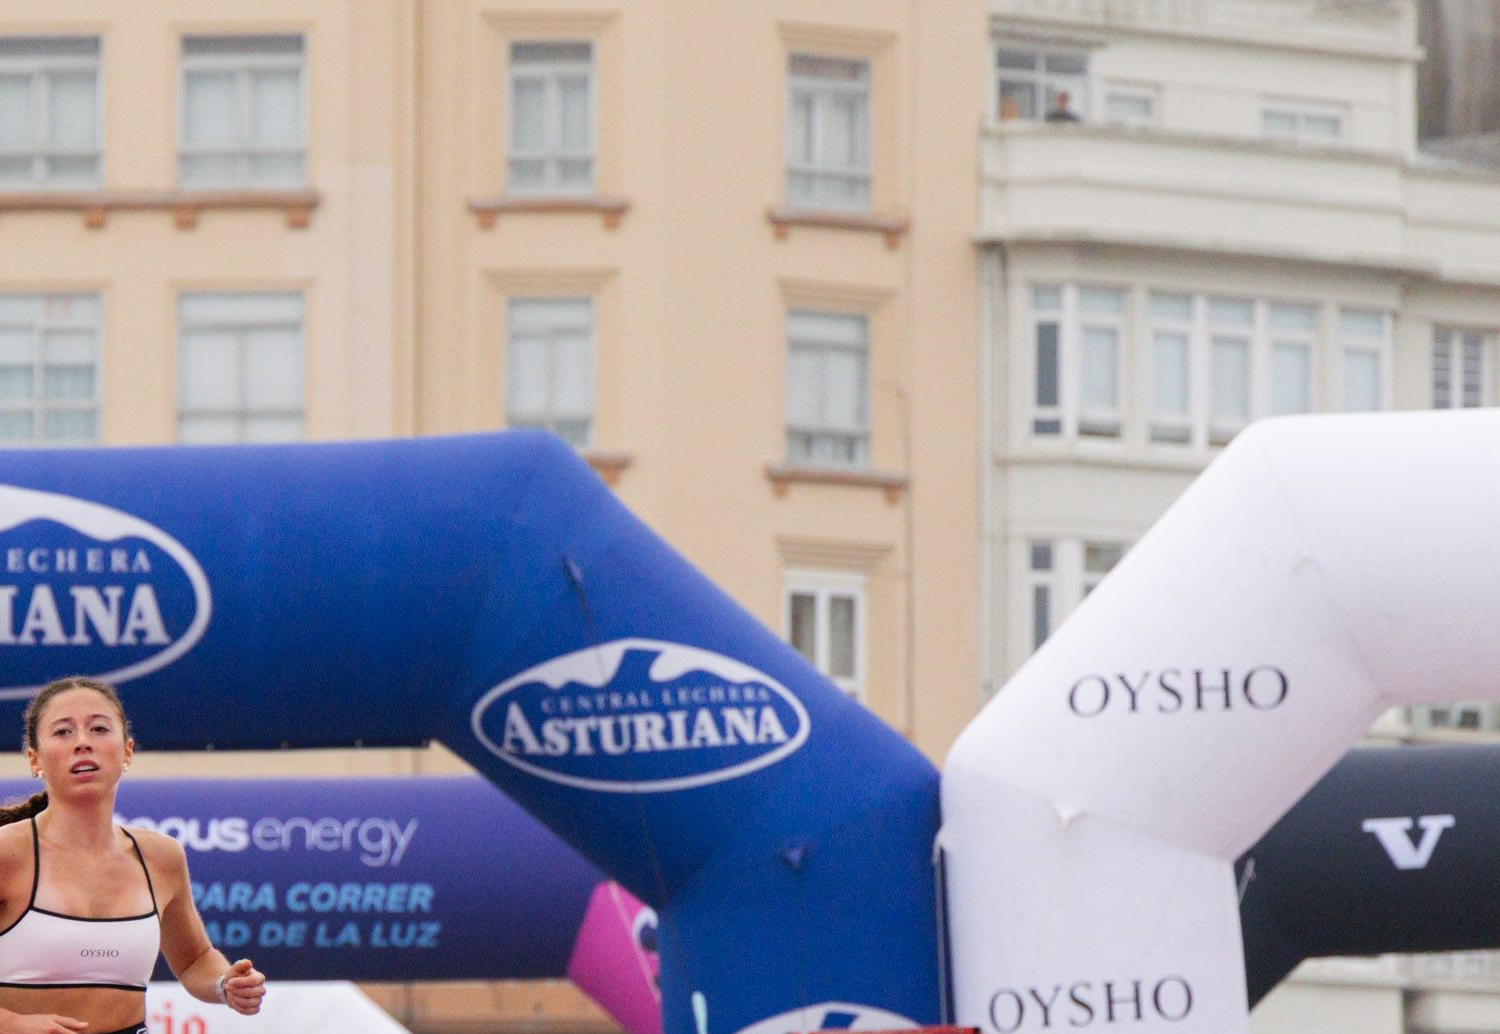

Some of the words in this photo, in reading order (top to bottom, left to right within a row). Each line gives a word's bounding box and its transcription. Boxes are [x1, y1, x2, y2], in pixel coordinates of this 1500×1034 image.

[541, 690, 651, 713] CENTRAL
[662, 685, 770, 705] LECHERA
[1069, 665, 1289, 717] OYSHO
[501, 702, 790, 756] ASTURIANA
[251, 816, 419, 867] energy
[286, 882, 434, 913] CORRER
[80, 948, 120, 958] OYSHO
[258, 922, 306, 948] DE
[314, 922, 360, 948] LA
[370, 922, 442, 948] LUZ
[989, 975, 1193, 1034] OYSHO
